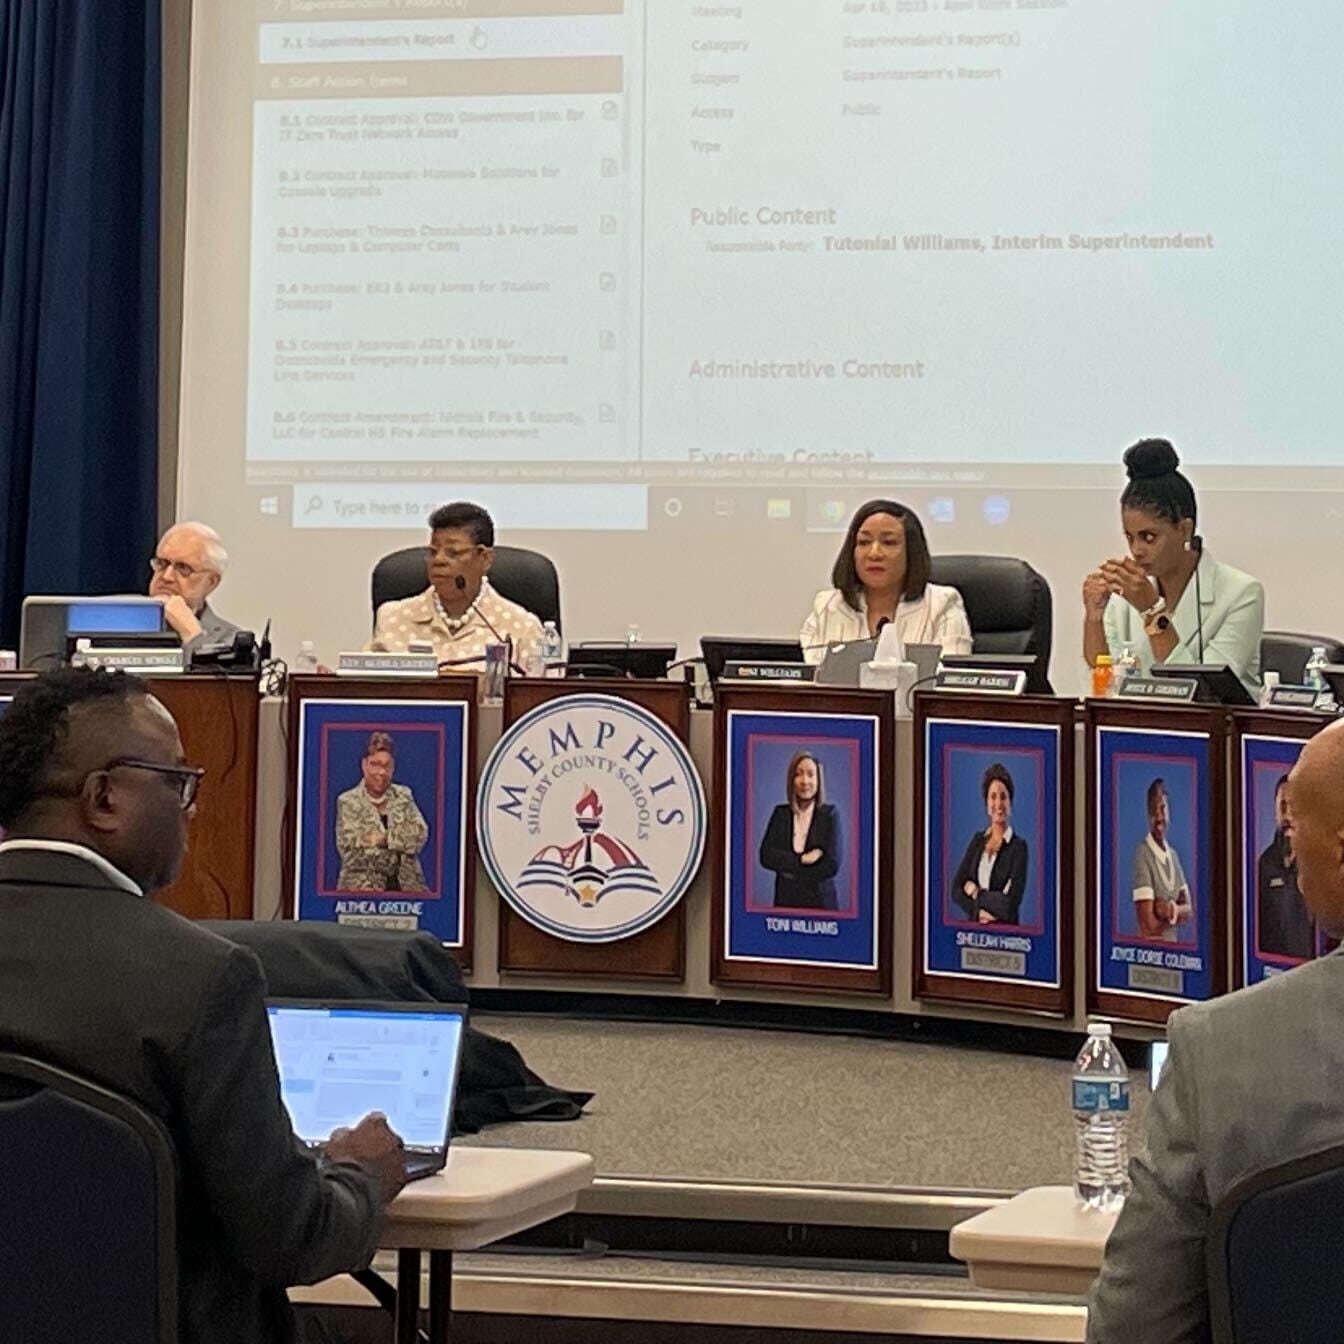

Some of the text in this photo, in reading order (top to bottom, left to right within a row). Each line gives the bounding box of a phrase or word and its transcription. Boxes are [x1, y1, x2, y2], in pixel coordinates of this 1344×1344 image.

[690, 106, 735, 120] Access
[690, 139, 722, 154] Type
[690, 206, 838, 226] Public Content
[822, 234, 897, 251] Tutonial
[902, 233, 986, 253] Williams,
[991, 233, 1064, 250] Interim
[1067, 232, 1215, 253] Superintendent
[688, 359, 926, 379] Administrative Content
[688, 447, 875, 463] Executive Content
[333, 499, 366, 518] Type
[369, 499, 402, 515] here
[405, 501, 420, 515] to
[496, 719, 685, 828] MEMPHIS
[528, 755, 652, 841] SHELBY COUNTY SCHOOLS
[335, 900, 377, 915] ALTHEA
[766, 916, 839, 936] TONI WILLIAMS
